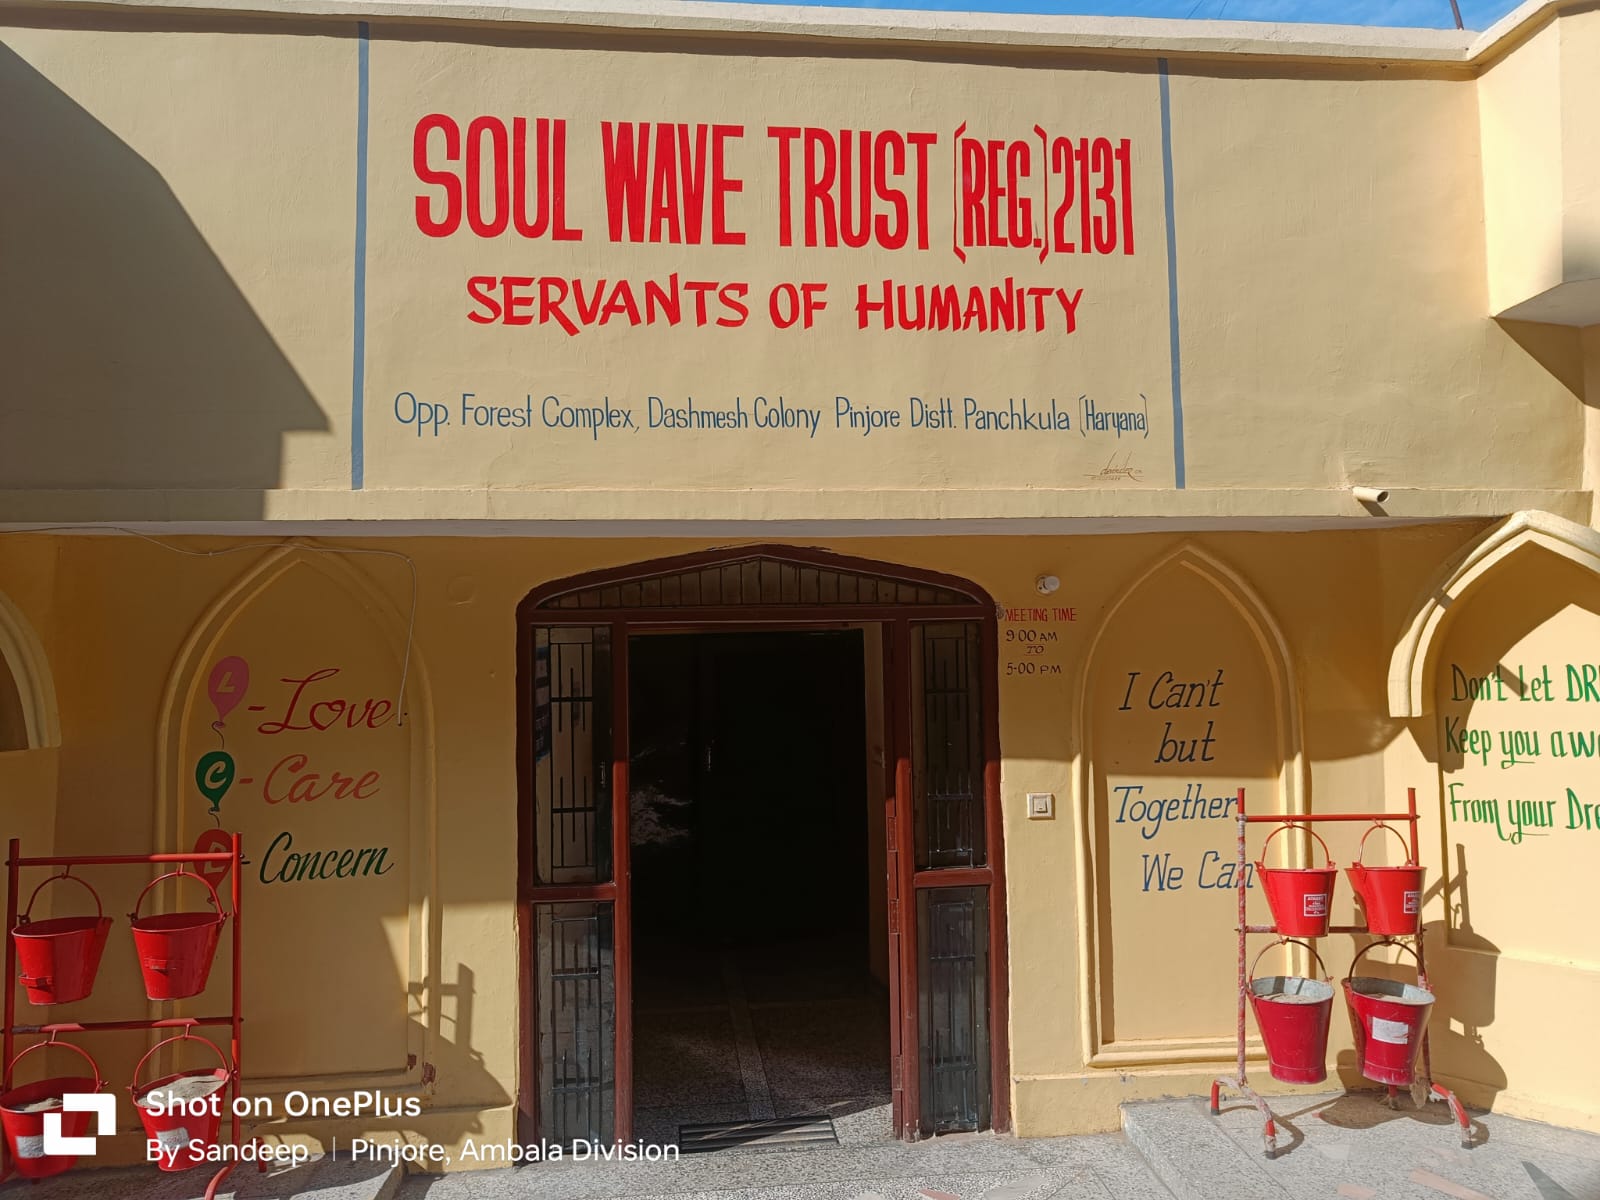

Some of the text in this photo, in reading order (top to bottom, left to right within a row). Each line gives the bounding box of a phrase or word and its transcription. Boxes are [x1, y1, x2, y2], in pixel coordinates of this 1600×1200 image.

[413, 113, 583, 241] SOUL
[600, 120, 746, 245] WAVE
[767, 126, 937, 250] TRUST
[466, 272, 1084, 336] SERVANTS OF HUMANITY
[394, 392, 1149, 441] Opp. Forest Complex, Dashmesh Colony Pinjore Distt. Panchkula (Haryana)
[1005, 608, 1077, 622] MEETING TIME
[1039, 632, 1058, 641] AM
[1026, 645, 1045, 654] TO
[1040, 664, 1062, 674] PM
[1119, 669, 1224, 710] I Can't
[1451, 663, 1600, 703] Don't Let DR
[1154, 721, 1216, 763] but
[1445, 716, 1492, 767] Keep
[1498, 730, 1541, 770] you
[204, 760, 227, 790] C
[263, 754, 380, 805] Care
[1113, 784, 1238, 840] Together
[1448, 782, 1511, 842] From
[1508, 798, 1557, 846] your
[259, 832, 394, 884] Concern
[1142, 853, 1184, 892] We
